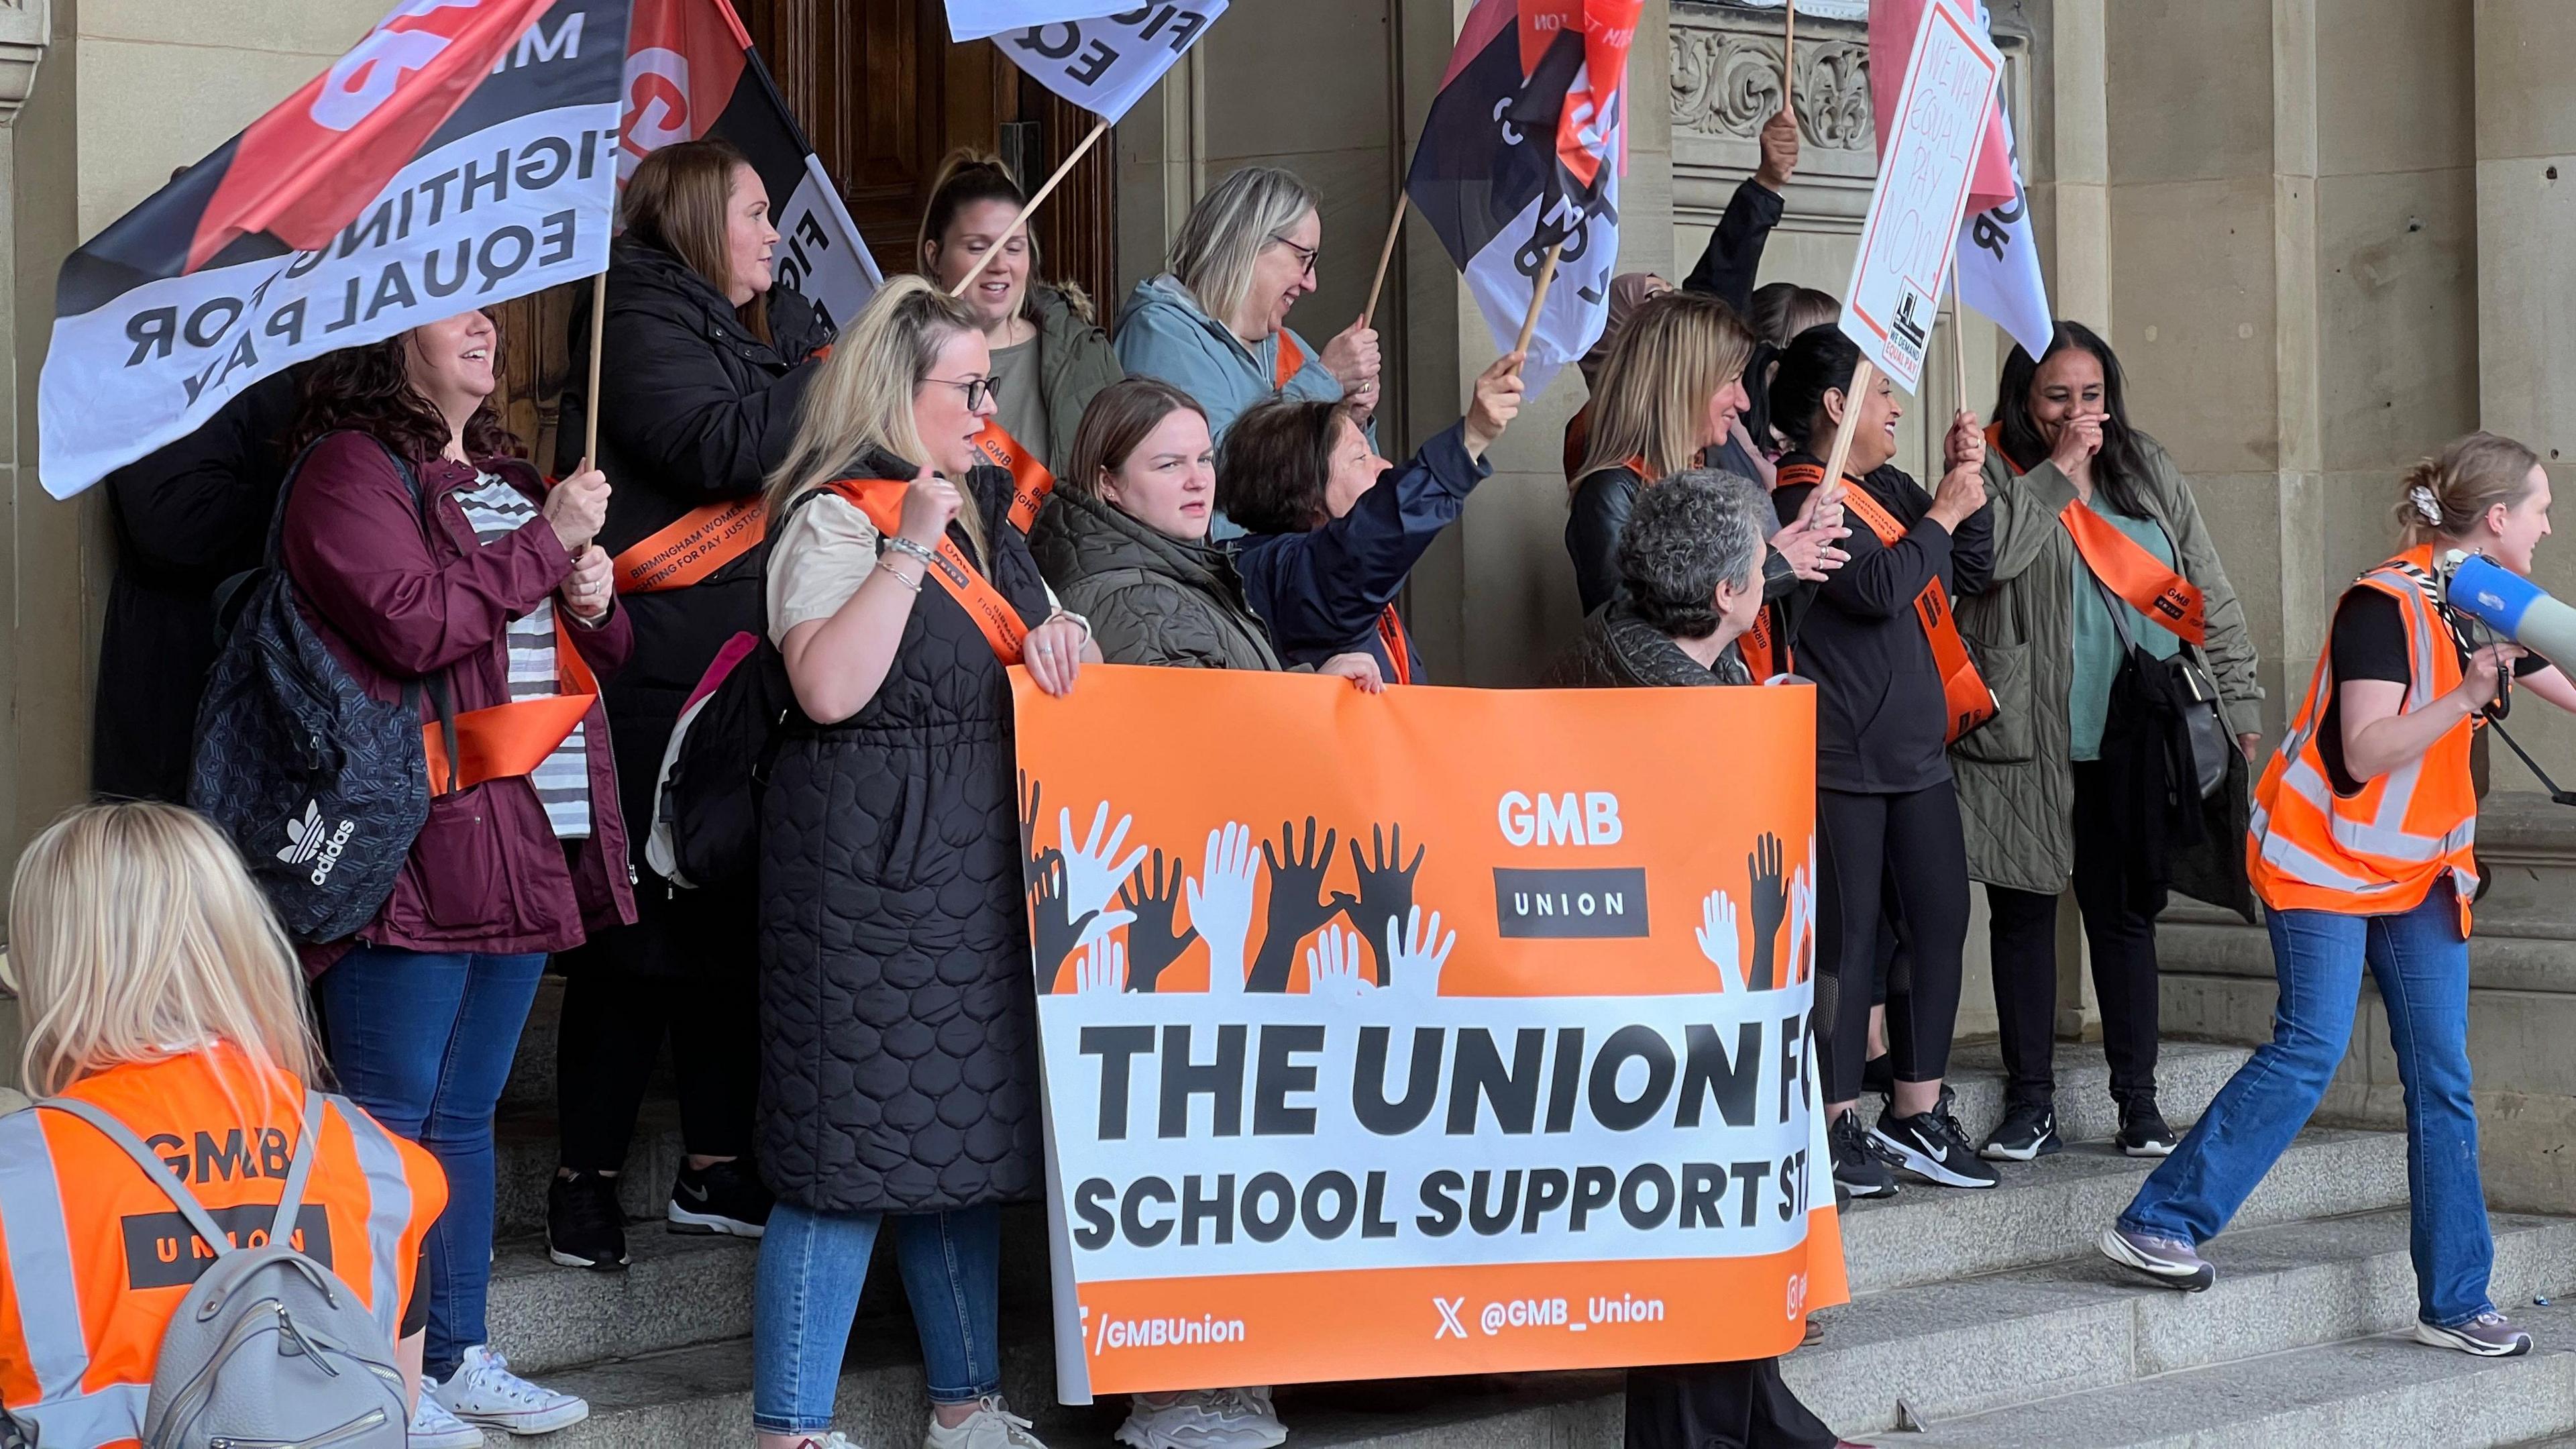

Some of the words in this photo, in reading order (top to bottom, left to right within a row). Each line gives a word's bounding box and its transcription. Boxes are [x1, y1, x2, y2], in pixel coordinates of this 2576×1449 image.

[1927, 38, 1956, 86] WE
[1911, 88, 1962, 164] EQUAL
[1909, 140, 1943, 211] PAY
[1886, 342, 1905, 366] EQUAL
[1904, 358, 1917, 374] PAY
[1890, 329, 1898, 343] WE
[1898, 335, 1919, 361] DEMAND
[986, 440, 1012, 466] GMB
[631, 531, 703, 579] BIRMINGHAM
[636, 564, 677, 592] GHTING
[677, 551, 700, 568] FOR
[700, 535, 721, 555] PAY
[2167, 588, 2190, 606] GMB
[1498, 790, 1622, 847] GMB
[311, 819, 355, 885] adidas
[1515, 892, 1623, 916] UNION
[1079, 1024, 1326, 1140] THE
[1352, 1022, 1762, 1136] UNION
[142, 1128, 291, 1184] GMB
[1074, 1170, 1397, 1250] SCHOOL
[1416, 1161, 1771, 1236] SUPPORT
[1778, 1143, 1809, 1222] ST
[1095, 1313, 1244, 1355] /GMBUnion
[1481, 1293, 1664, 1336] @GMB_Union
